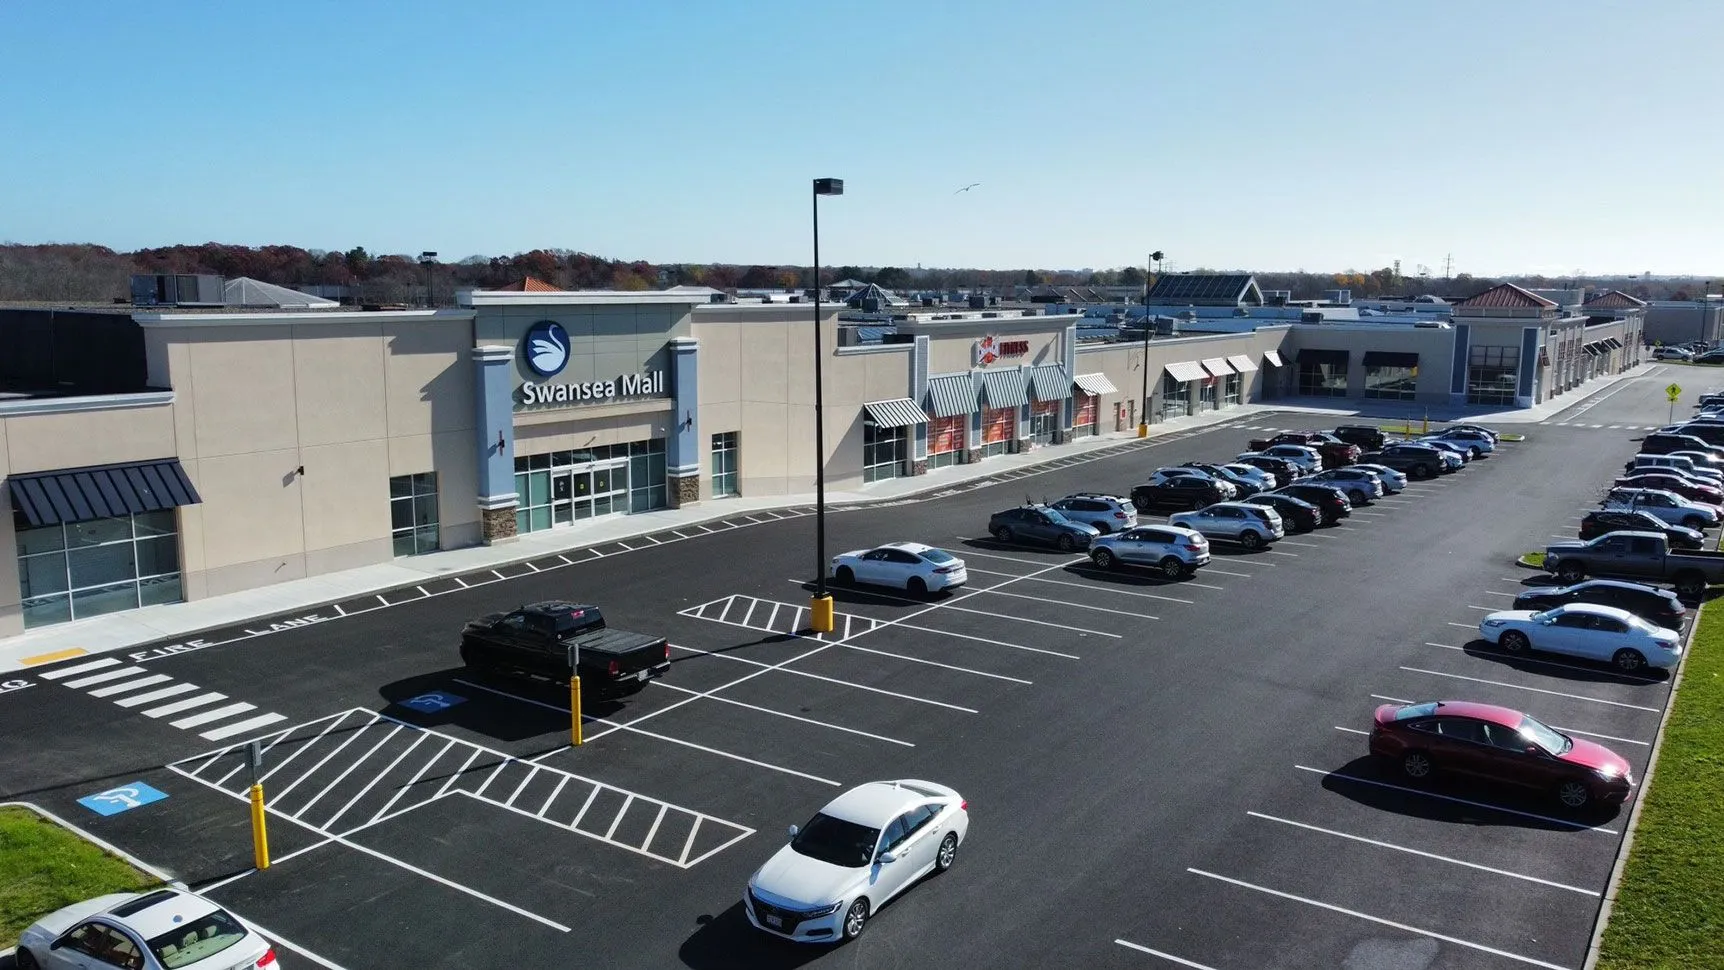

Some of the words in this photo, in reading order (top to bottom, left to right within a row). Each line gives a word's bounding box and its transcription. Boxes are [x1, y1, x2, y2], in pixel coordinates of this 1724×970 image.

[523, 381, 616, 405] Swansea
[622, 370, 664, 396] Mall
[128, 638, 214, 662] FIRE
[245, 614, 328, 635] LANE
